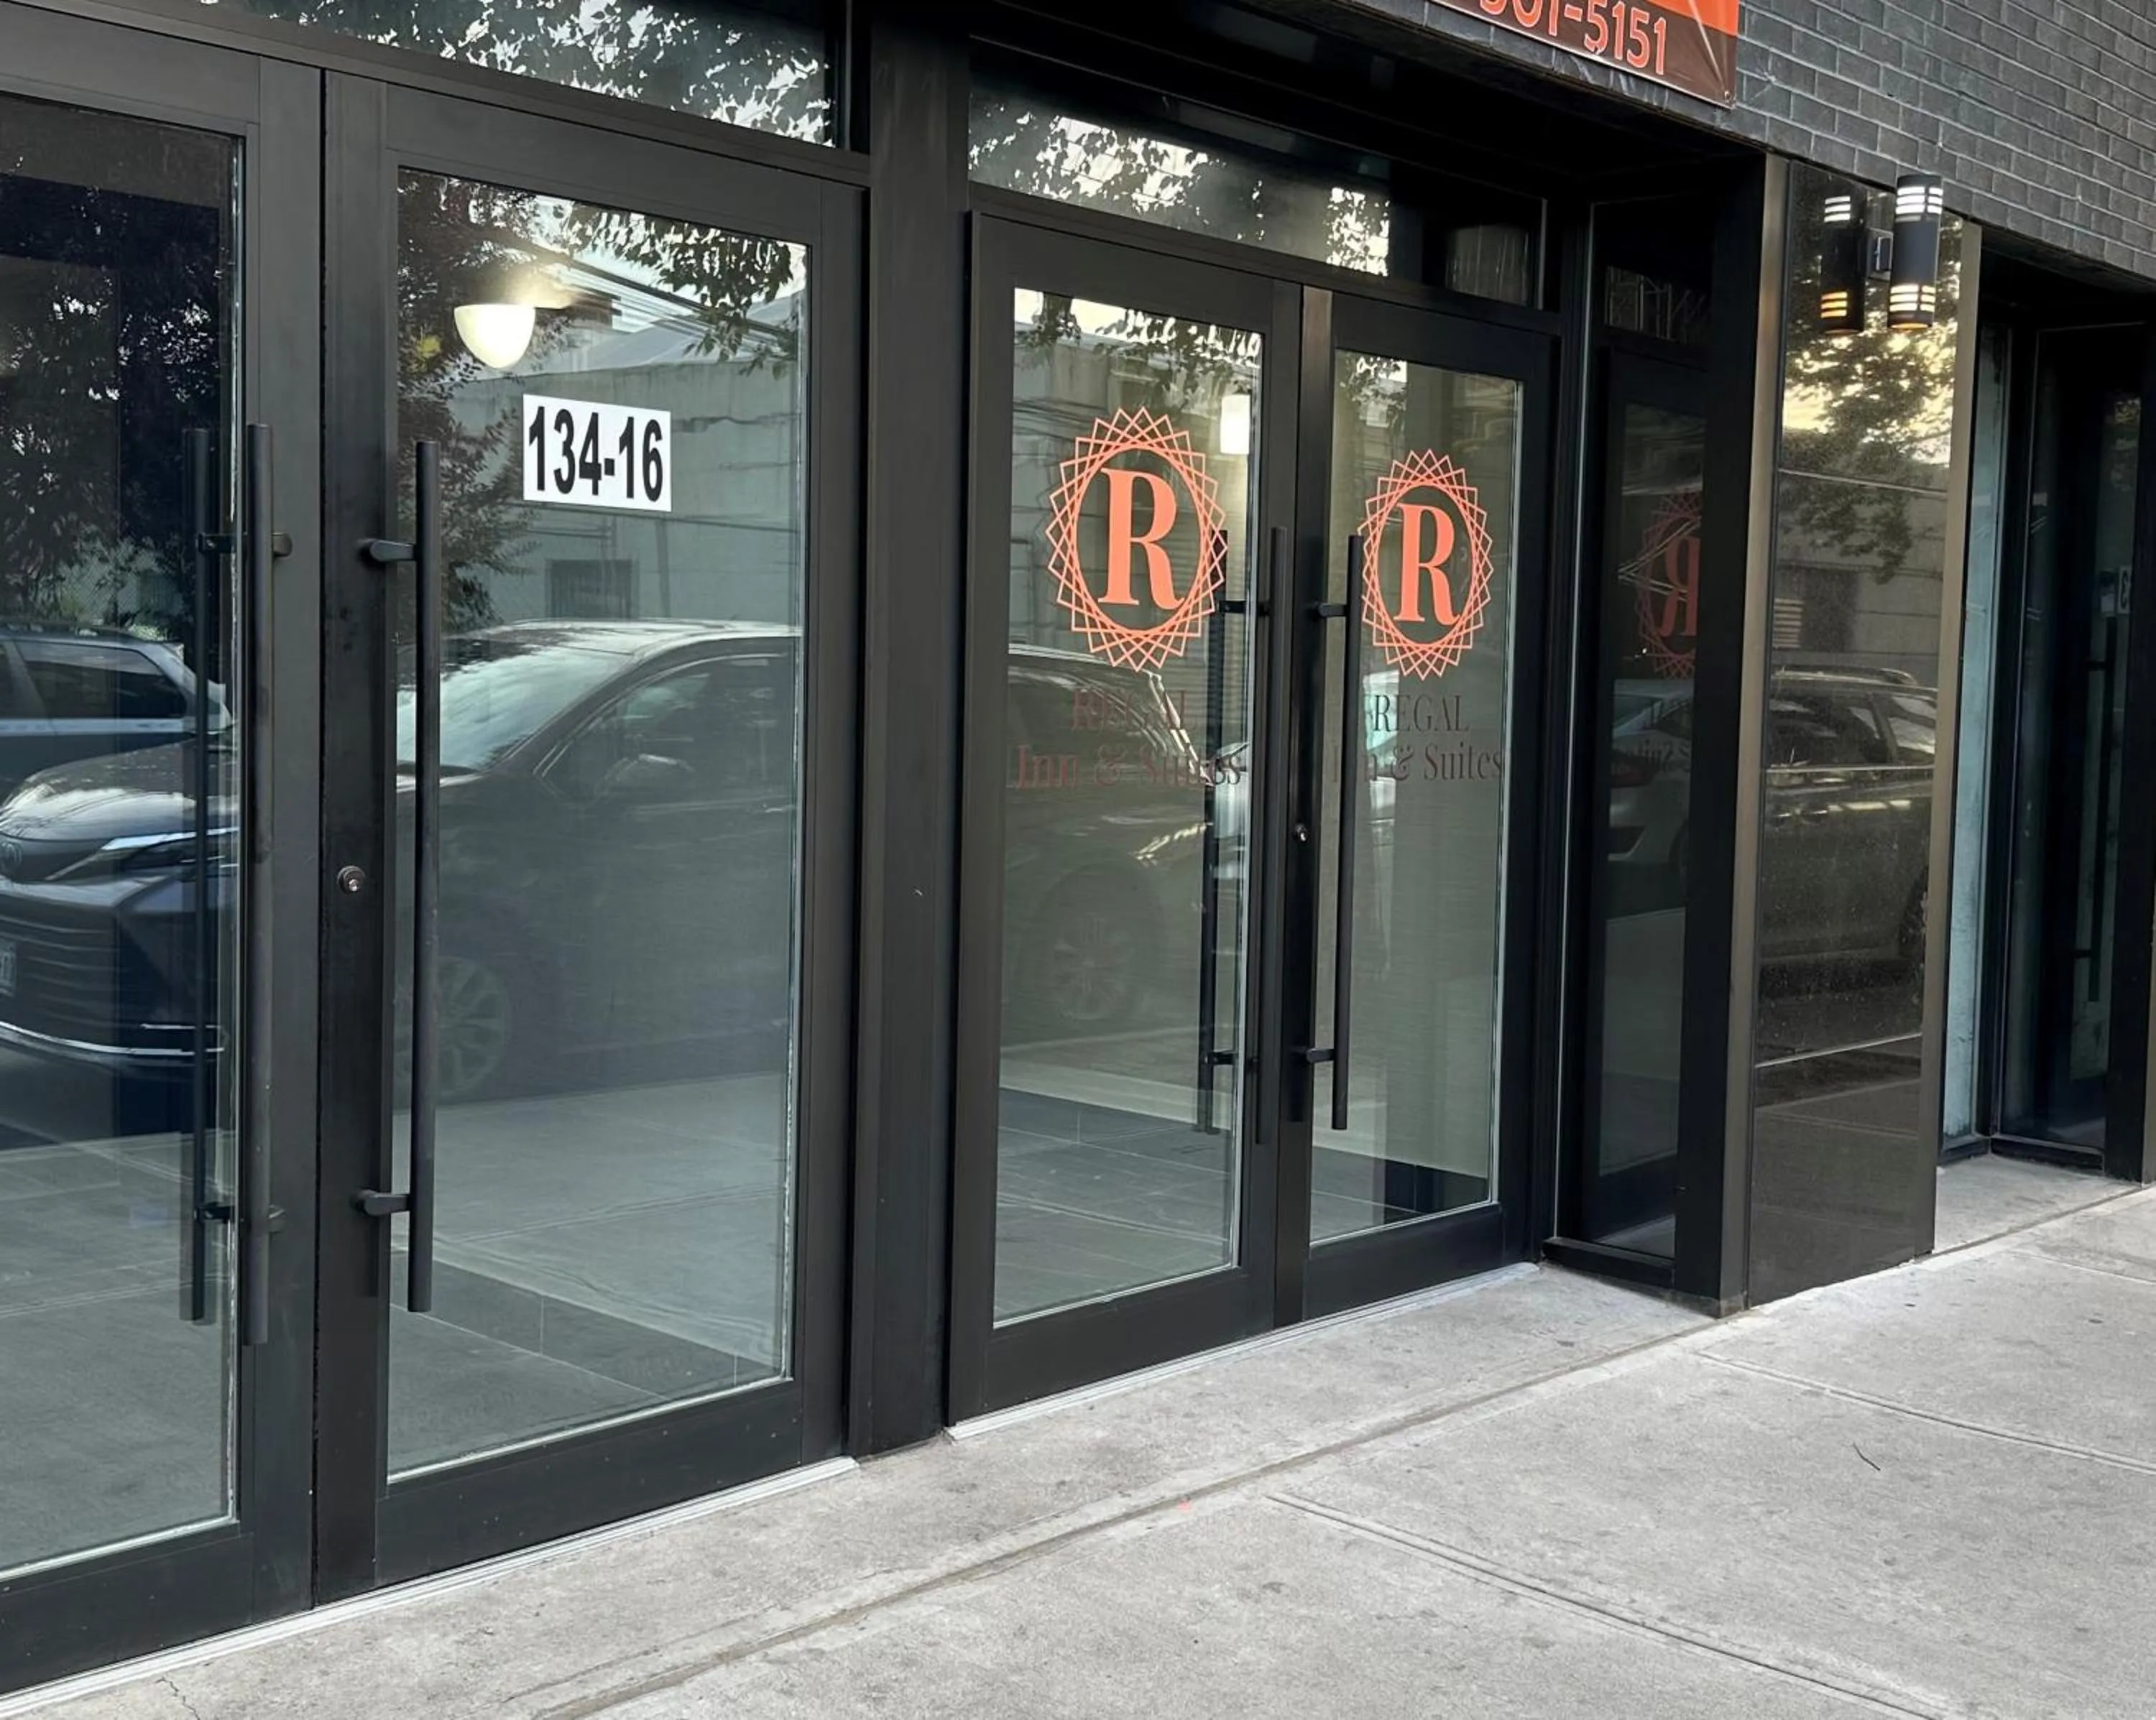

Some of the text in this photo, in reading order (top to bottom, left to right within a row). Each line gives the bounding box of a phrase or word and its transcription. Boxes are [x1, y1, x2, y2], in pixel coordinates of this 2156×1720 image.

[1480, 0, 1667, 75] 1-5151
[529, 406, 663, 501] 134-16
[1098, 468, 1185, 610] R
[1393, 503, 1460, 626] R
[1373, 694, 1469, 732] REGAL
[1015, 744, 1078, 789] Inn
[1093, 744, 1128, 785] &
[1390, 744, 1414, 782] &
[1424, 741, 1502, 781] Suites
